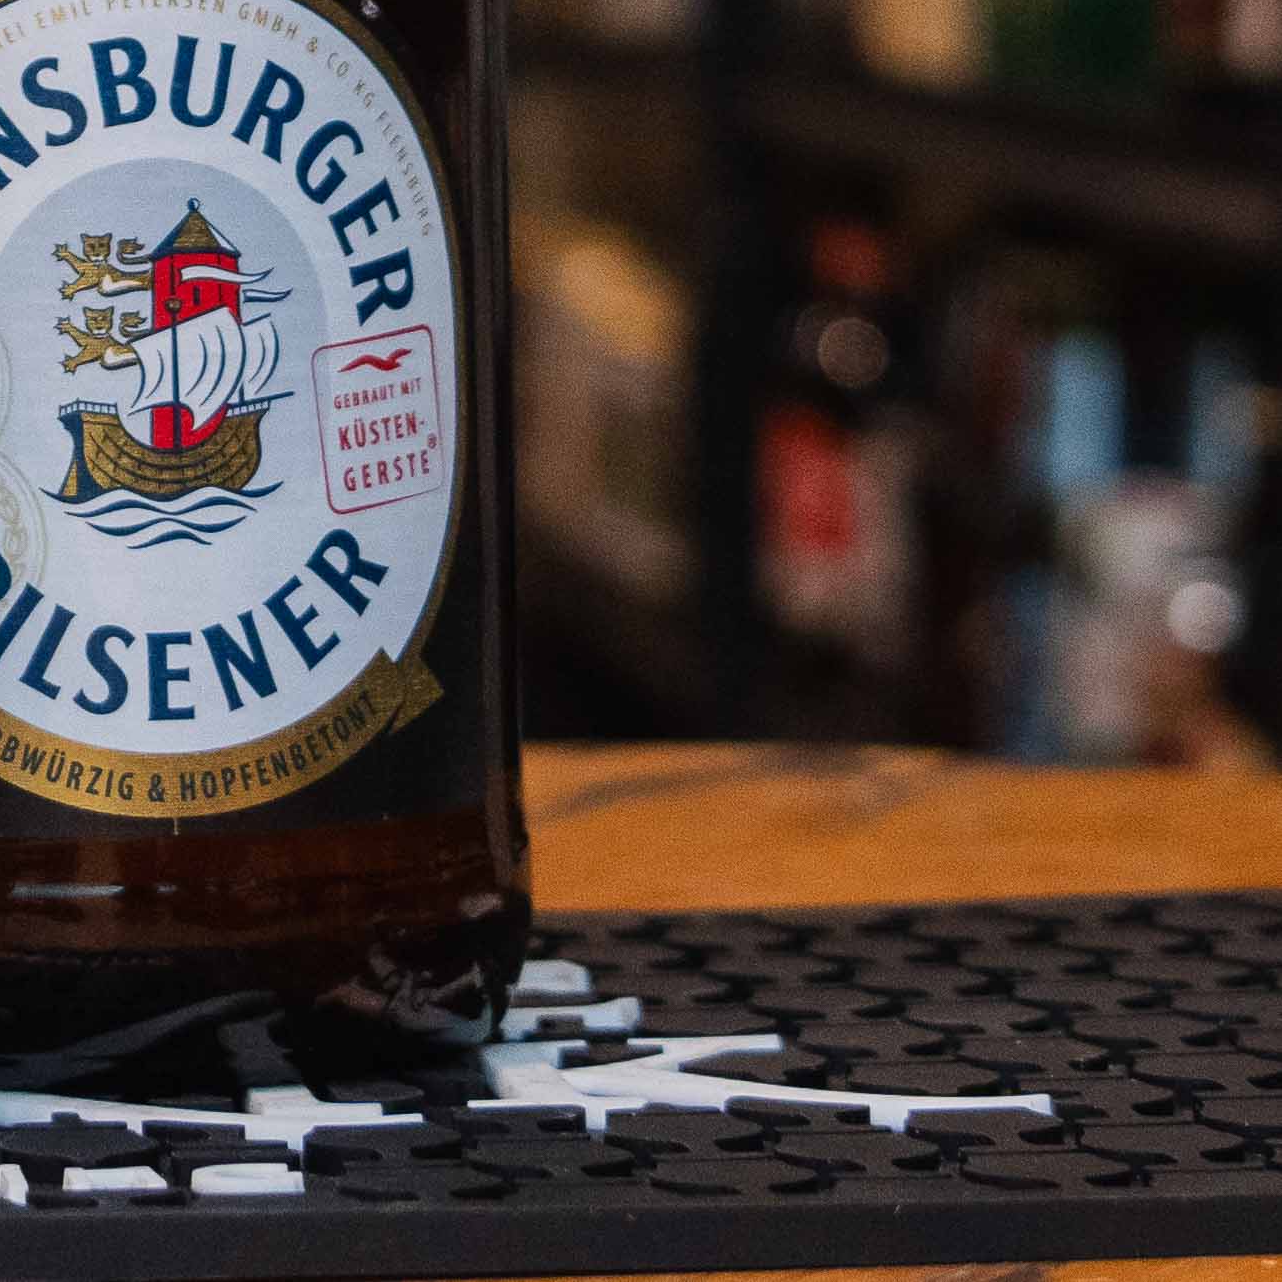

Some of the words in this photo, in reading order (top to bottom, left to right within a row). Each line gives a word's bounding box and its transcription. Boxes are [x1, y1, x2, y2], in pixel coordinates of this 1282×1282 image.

[237, 2, 301, 40] GMBH
[334, 383, 395, 410] GEBRAUT
[400, 376, 422, 395] MIT
[338, 409, 426, 451] KÜSTEN-
[147, 775, 166, 803] &
[179, 688, 381, 803] HOPFENBETONT
